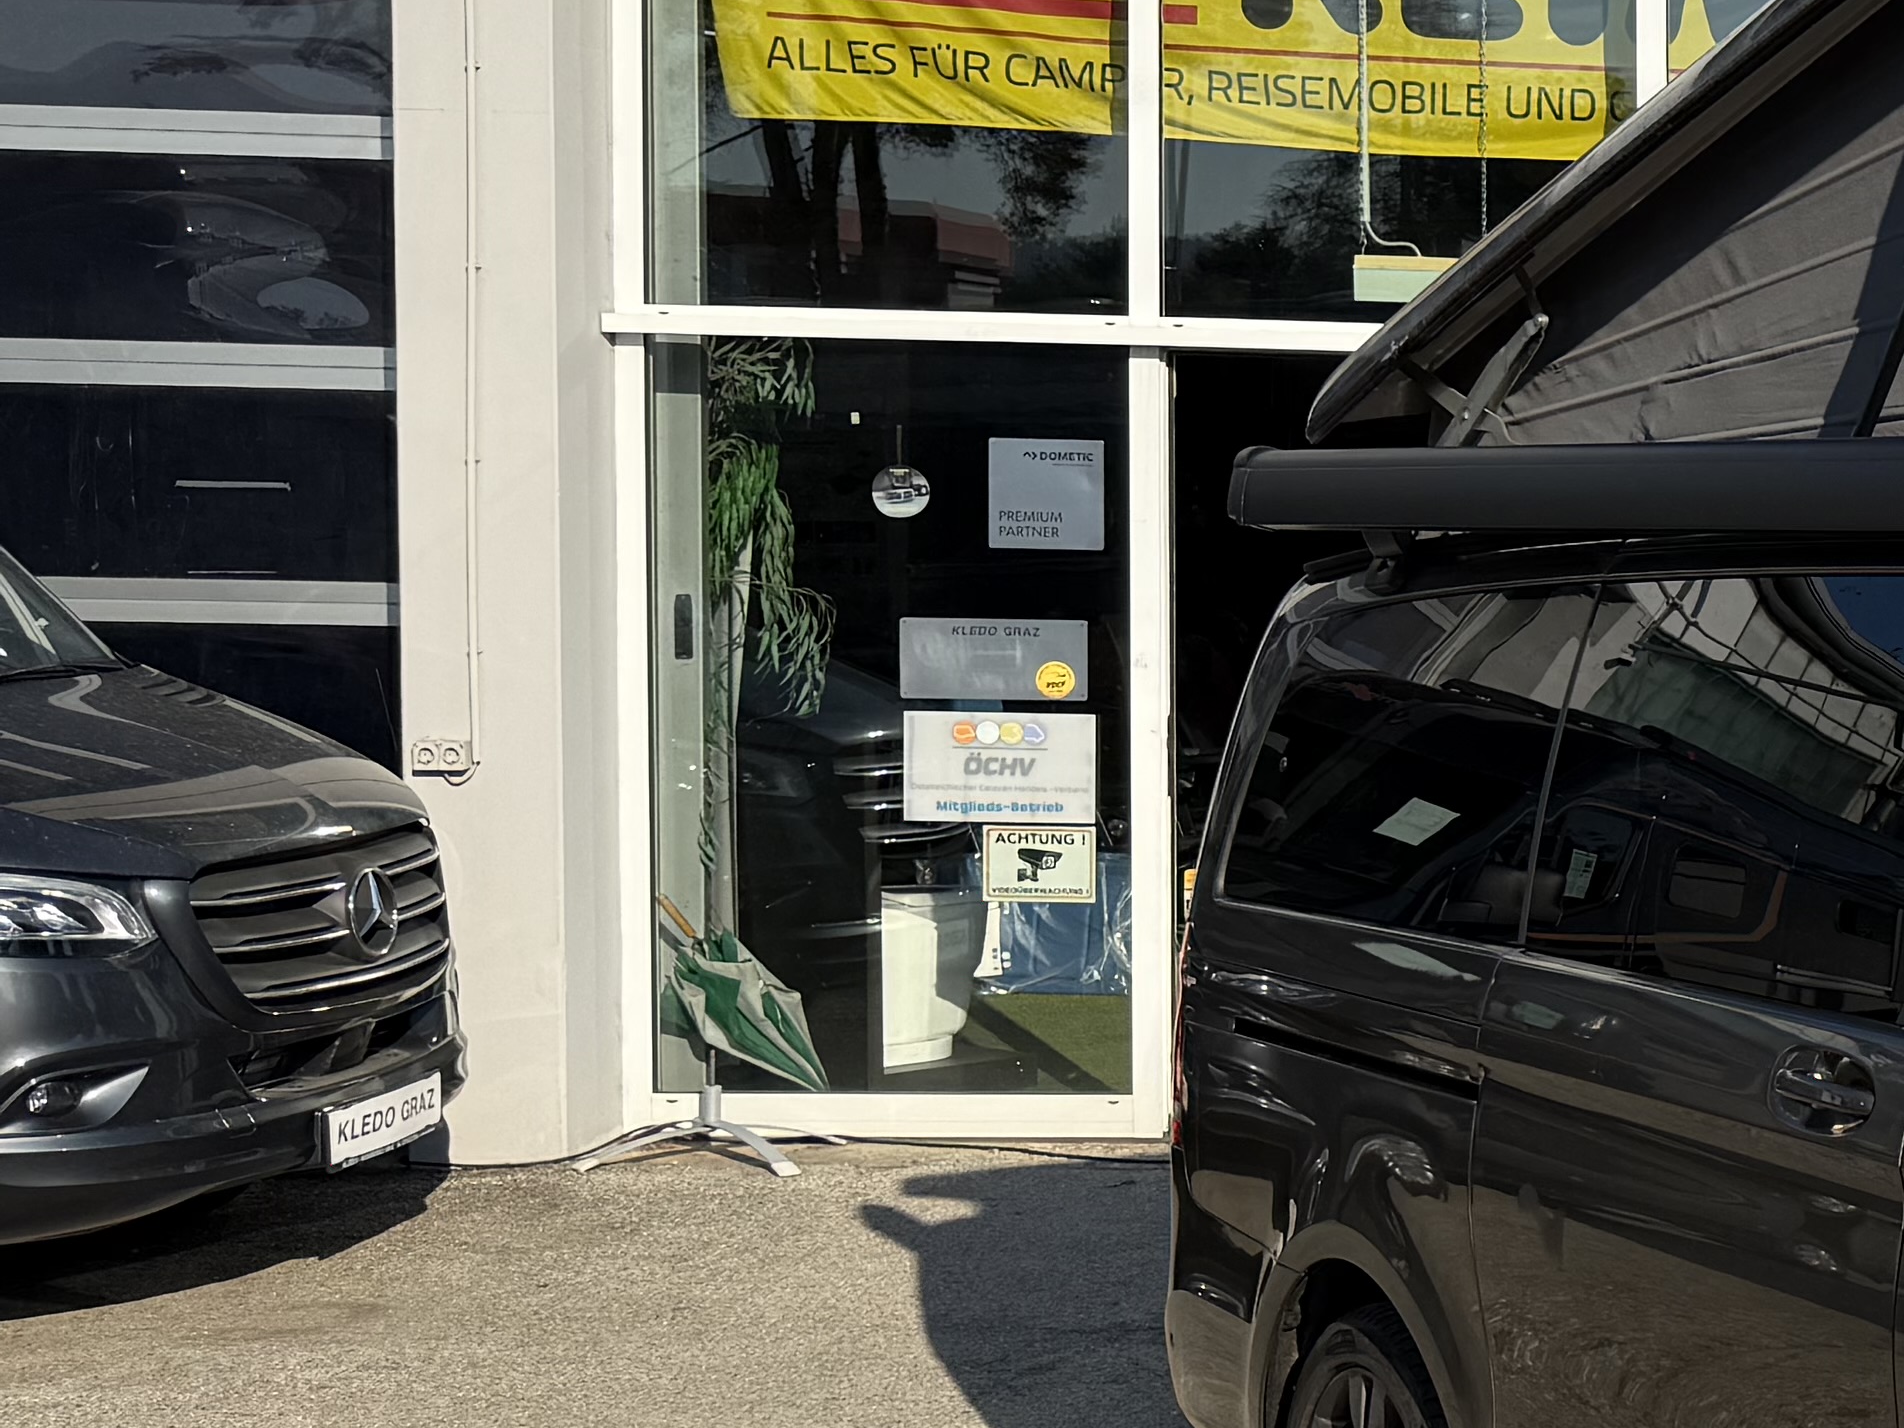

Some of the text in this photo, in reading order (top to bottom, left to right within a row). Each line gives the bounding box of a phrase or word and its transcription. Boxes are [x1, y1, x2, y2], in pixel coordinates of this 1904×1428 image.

[766, 35, 898, 76] ALLES
[908, 42, 992, 83] FÜR
[1004, 52, 1195, 106] CAMPR,
[1206, 67, 1489, 118] REISEMOBILE
[1504, 84, 1597, 122] UND
[1039, 451, 1094, 463] DOMETIC
[998, 510, 1064, 524] PREMIUM
[998, 525, 1060, 539] PARTNER
[951, 625, 1041, 638] KLEDO GRAZ
[963, 752, 1037, 777] ÖCHV
[994, 832, 1076, 846] ACHTUNG
[337, 1087, 435, 1145] KLEDO GRAZ
